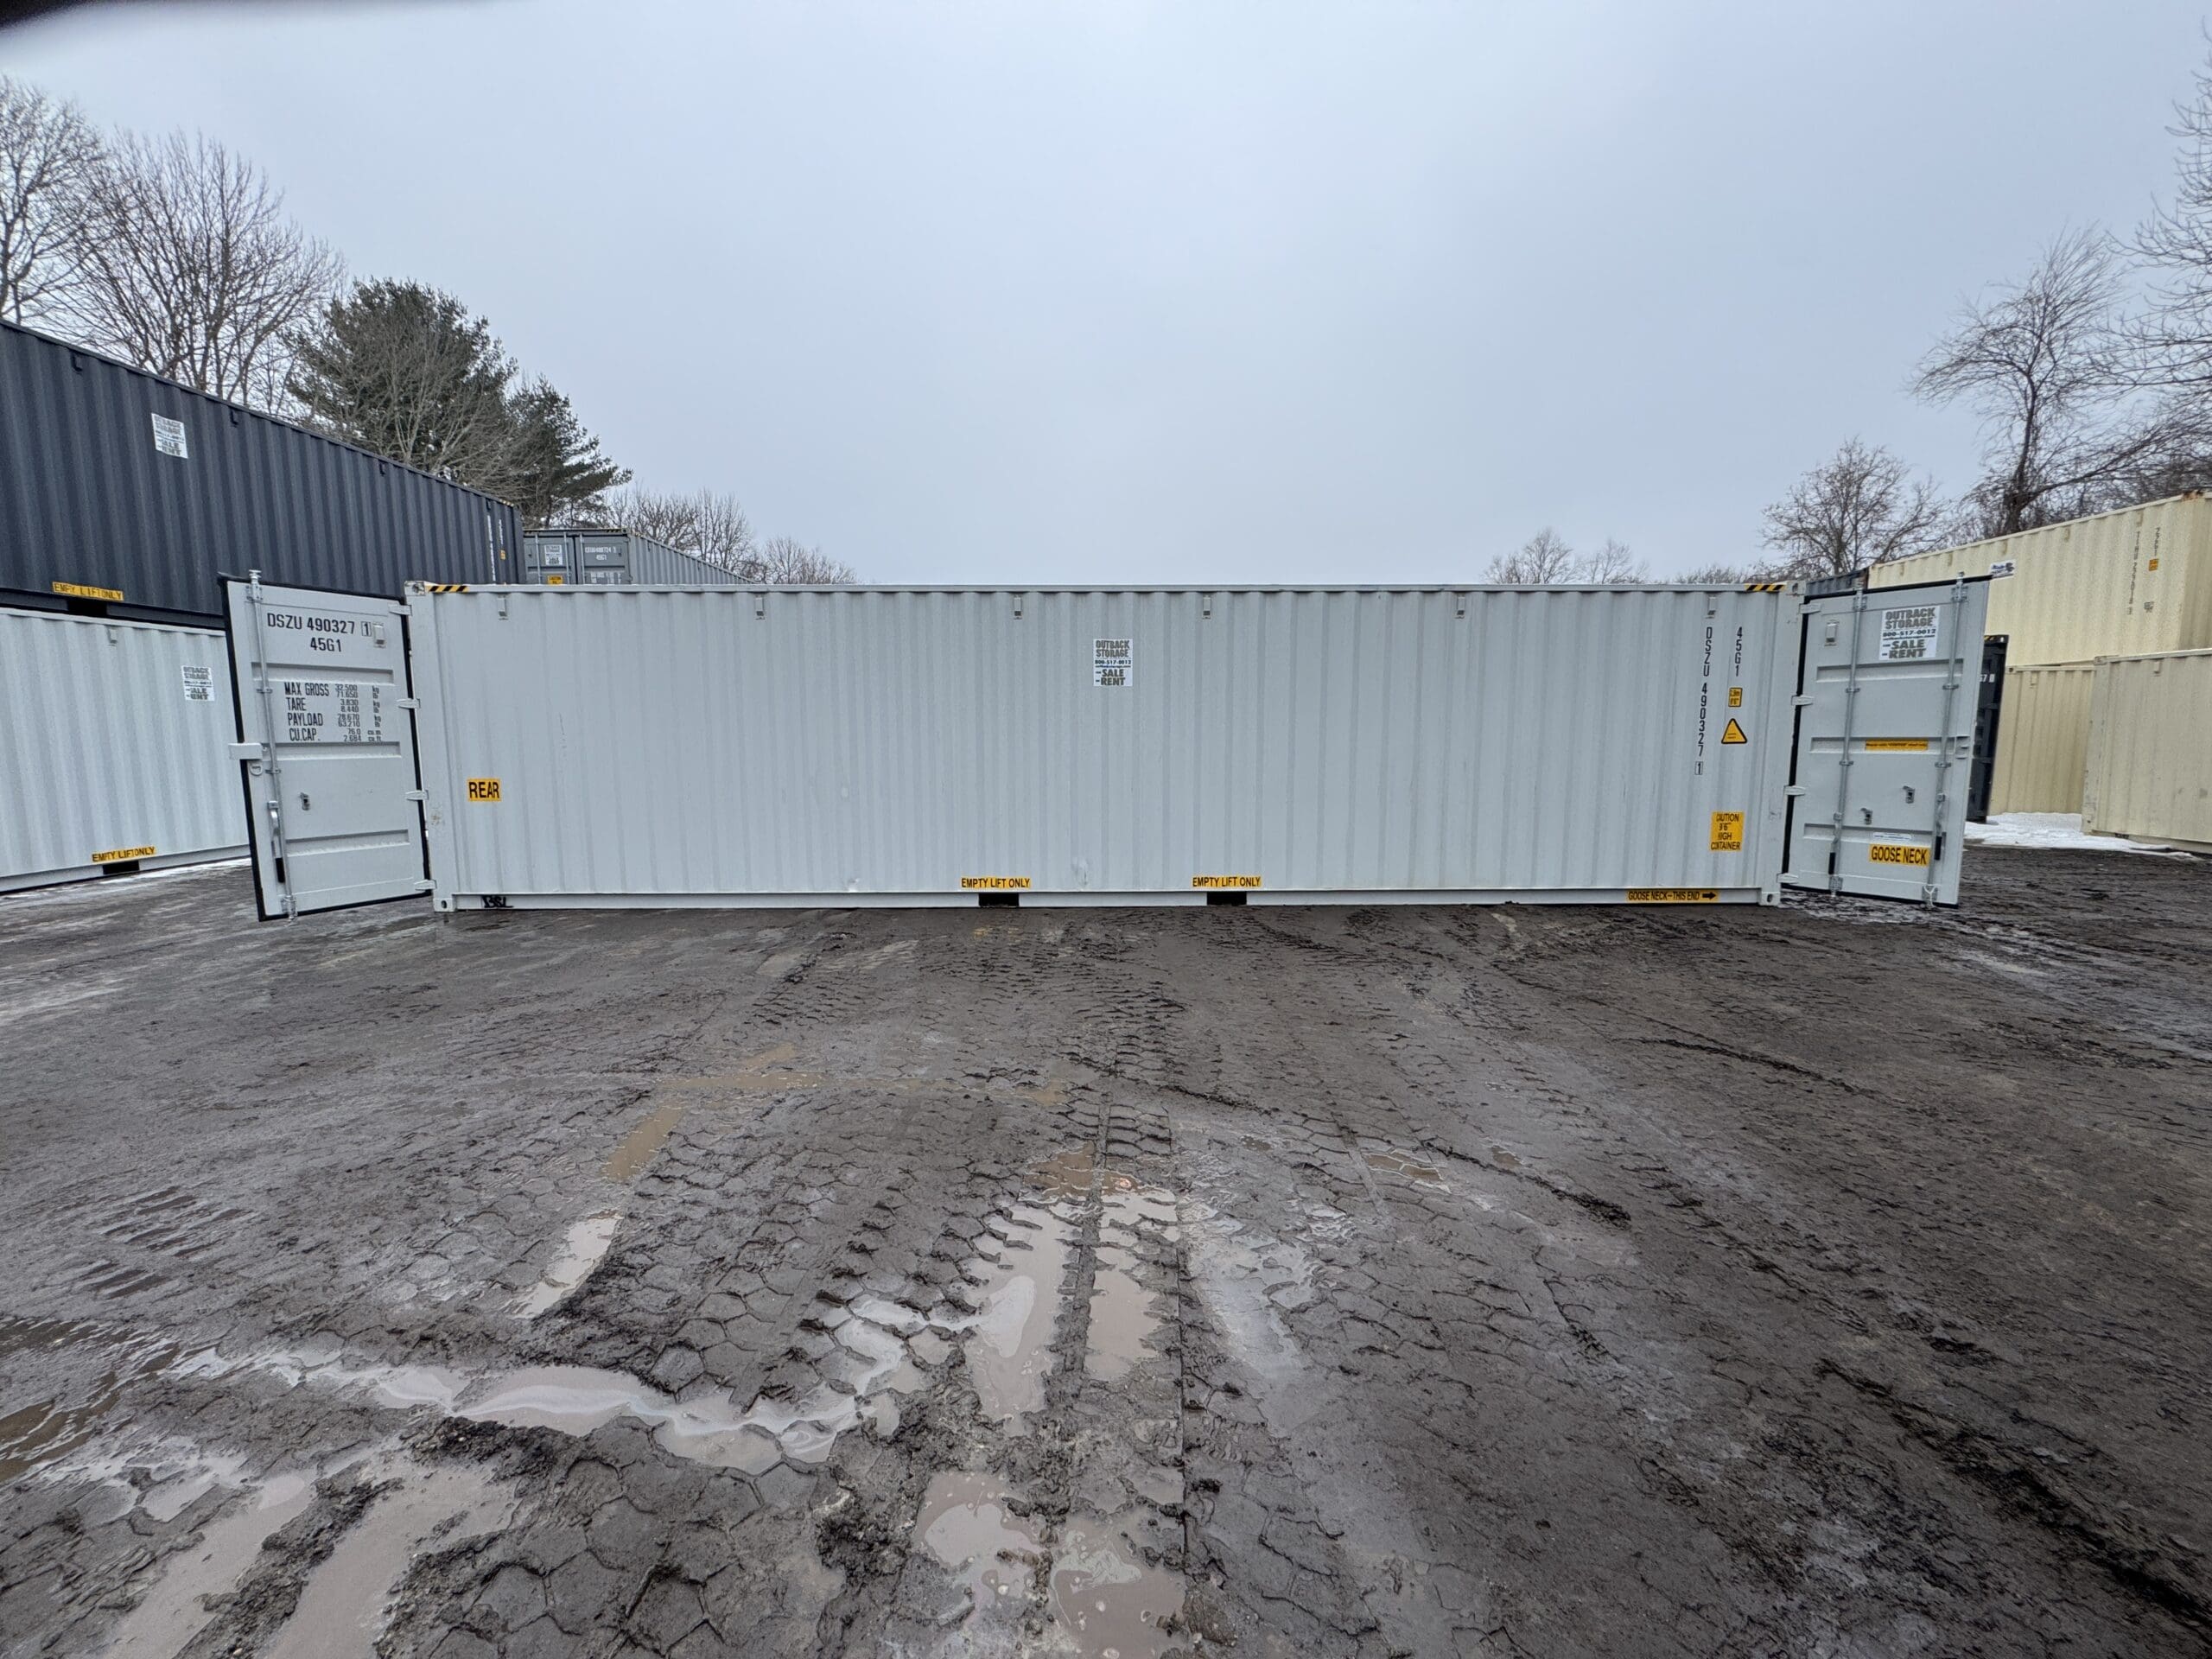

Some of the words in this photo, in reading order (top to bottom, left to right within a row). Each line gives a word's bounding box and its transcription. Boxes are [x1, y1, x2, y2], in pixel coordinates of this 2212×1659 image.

[1885, 607, 1936, 620] OUTBACK
[267, 613, 302, 630] DSZU
[307, 617, 355, 634] 490327
[1885, 617, 1934, 629] STORAGE
[310, 637, 342, 652] 45G1
[1096, 640, 1129, 649] OUTBACK
[1891, 639, 1925, 650] SALE
[1096, 649, 1129, 658] STORAGE
[1703, 626, 1713, 677] DSZU
[1889, 648, 1926, 658] RENT
[1102, 669, 1124, 677] SALE
[1101, 677, 1125, 685] RENT
[284, 682, 302, 696] MAX
[305, 683, 329, 696] GROSS
[286, 697, 307, 711] TARE
[288, 713, 323, 726] PAYLOAD
[1698, 683, 1707, 757] 490327
[468, 781, 500, 798] REAR
[135, 847, 155, 856] ONLY
[1872, 846, 1901, 862] GOOSE
[1903, 848, 1927, 865] NECK
[961, 878, 988, 887] EMPTY
[990, 878, 1007, 887] LIFT
[1008, 878, 1030, 887] ONLY
[1192, 877, 1220, 887] EMPTY
[1222, 877, 1237, 887] LIFT
[1239, 877, 1261, 887] ONLY
[1628, 891, 1649, 900] GOOSE
[1688, 891, 1700, 900] END
